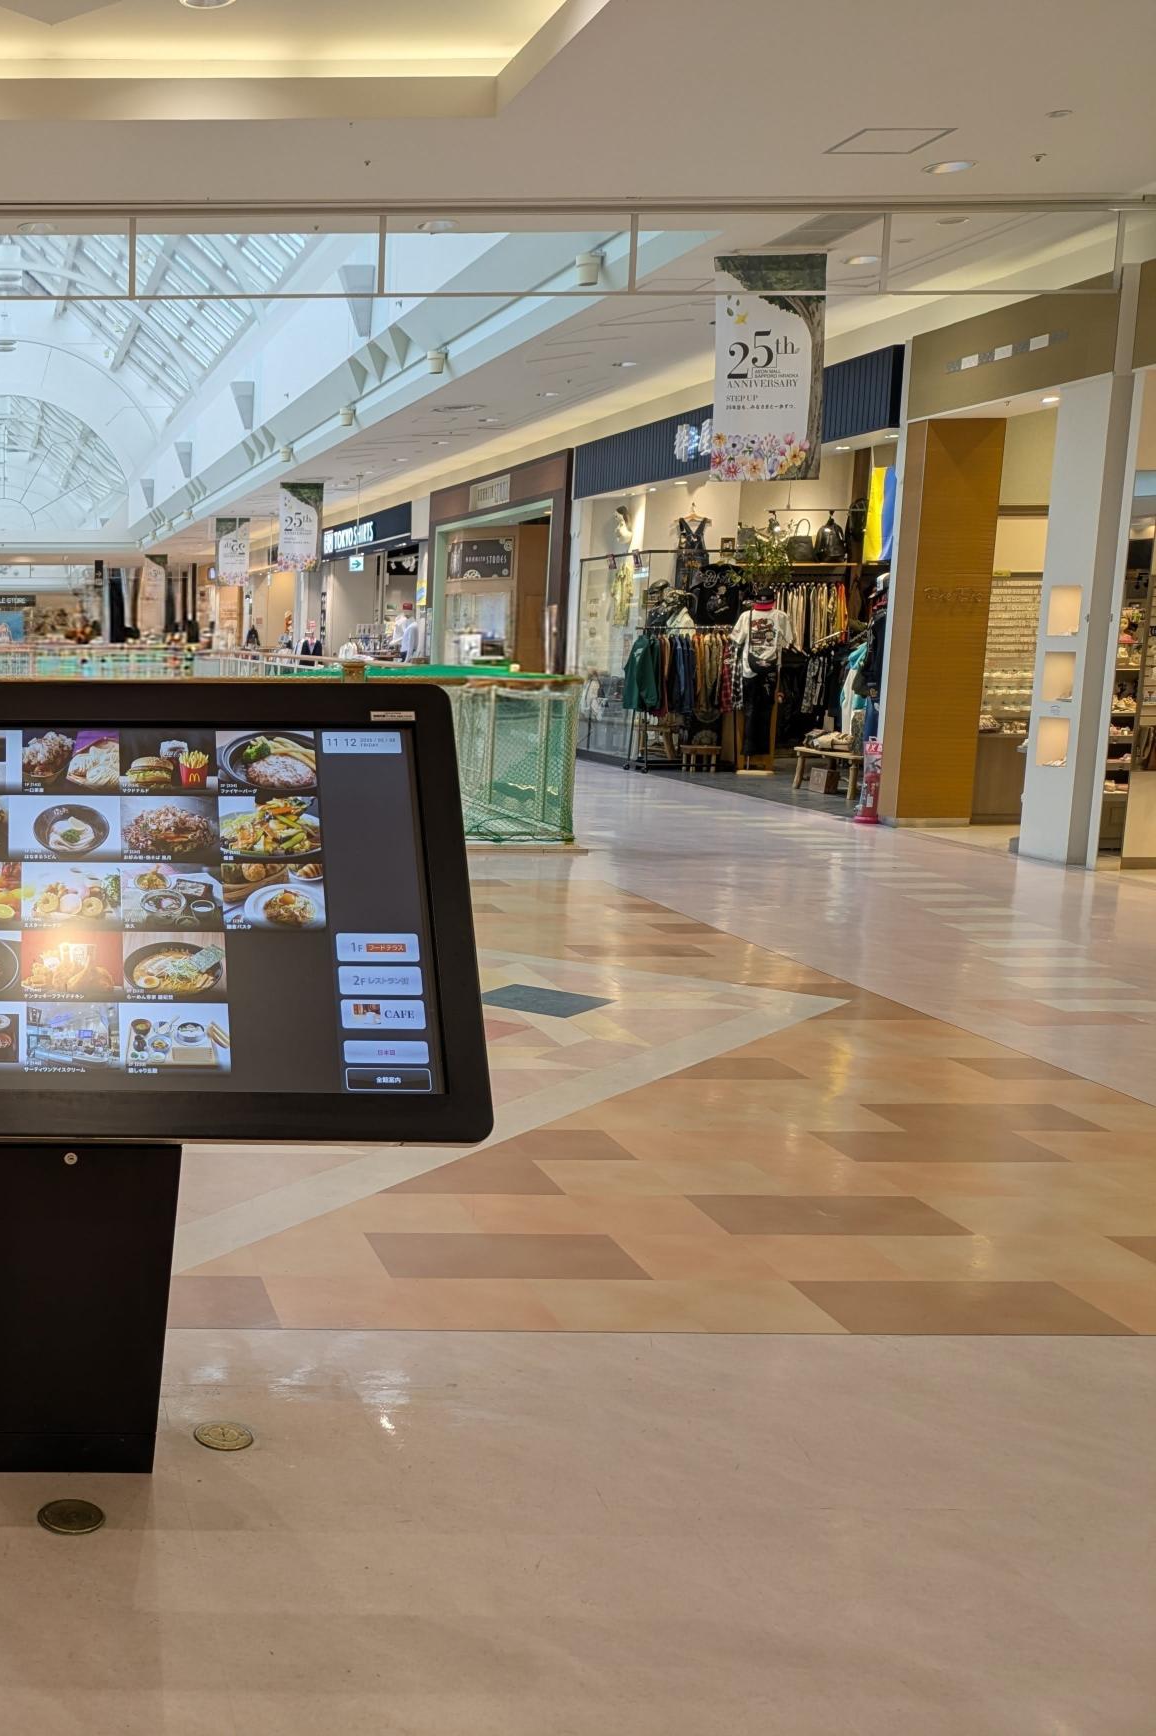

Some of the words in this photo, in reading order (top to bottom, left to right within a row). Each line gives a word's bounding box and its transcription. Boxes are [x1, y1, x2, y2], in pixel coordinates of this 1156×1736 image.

[726, 329, 800, 379] 25th
[727, 380, 798, 389] ANNIVERSARY
[351, 942, 362, 953] 1F
[367, 944, 405, 952] フードテラス
[353, 976, 365, 986] 2F
[384, 1010, 415, 1019] CAFE
